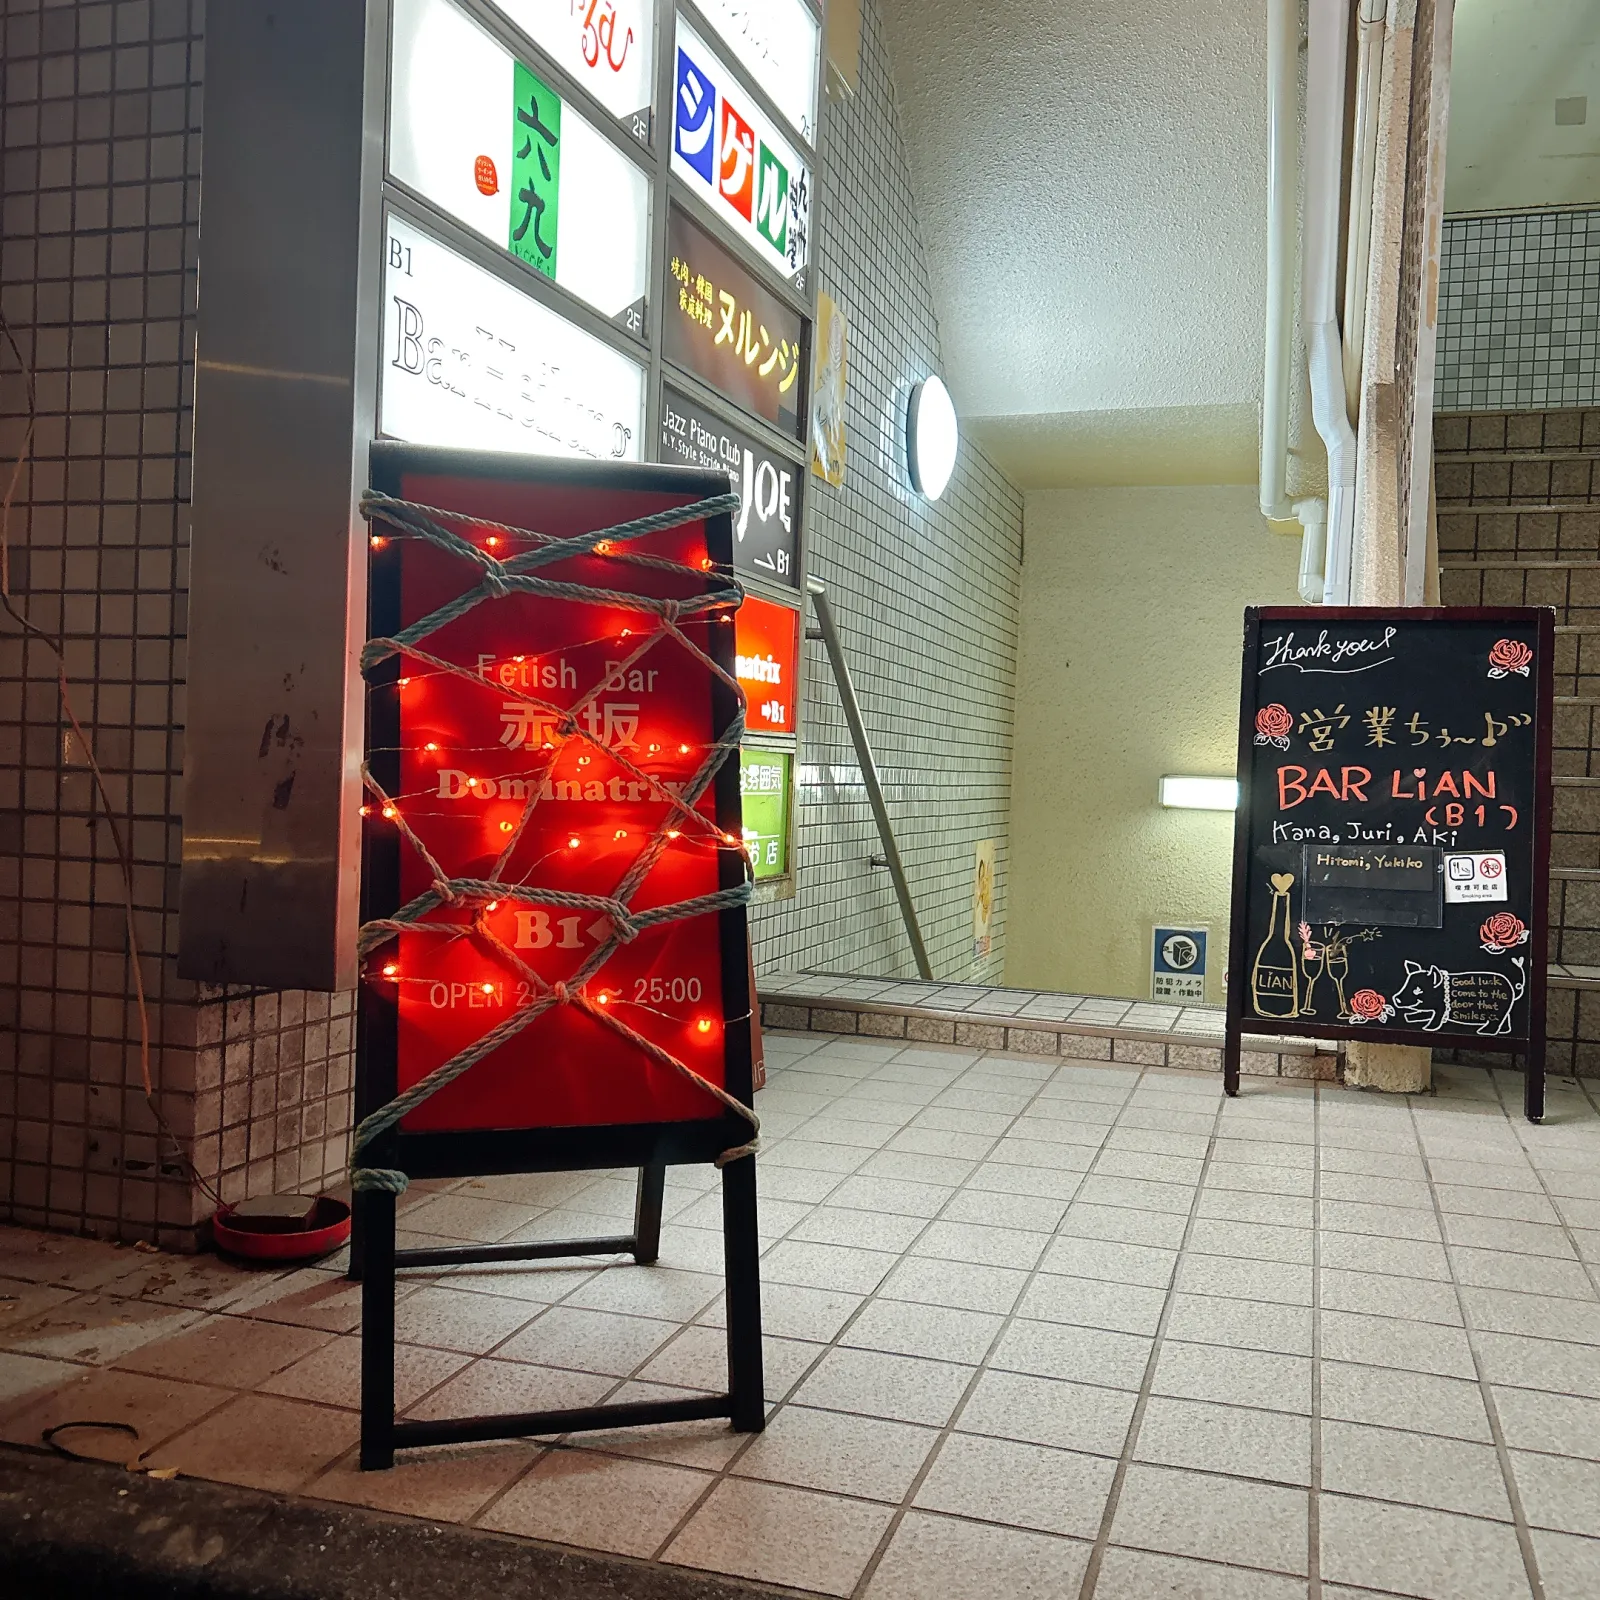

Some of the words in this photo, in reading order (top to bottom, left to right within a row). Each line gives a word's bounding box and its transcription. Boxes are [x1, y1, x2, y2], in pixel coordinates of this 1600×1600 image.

[631, 115, 648, 140] 2F
[679, 68, 788, 243] シゲル
[513, 95, 559, 260] 六九
[388, 235, 414, 278] B1
[626, 307, 642, 332] 2F
[714, 289, 799, 393] ヌルンジ
[662, 404, 687, 437] Jazz
[690, 418, 717, 454] Piano
[719, 435, 741, 466] Club
[736, 448, 791, 543] JOE
[776, 548, 790, 576] B1
[1263, 629, 1333, 666] Thank
[478, 653, 577, 690] Fetish
[605, 660, 659, 693] Bar
[499, 700, 641, 752] 赤坂
[771, 700, 785, 724] B1
[435, 769, 688, 803] Dominatrix
[1276, 765, 1373, 811] BAR
[1425, 802, 1518, 830] (B1)
[1272, 820, 1340, 844] Kana,
[1347, 822, 1405, 844] Juri,
[1316, 853, 1371, 871] Hitomi,
[1374, 854, 1423, 869] Yukiko
[1454, 883, 1498, 891] 喫煙可能店
[513, 909, 585, 949] B1
[429, 981, 503, 1009] OPEN
[634, 977, 702, 1004] 25:00
[1155, 976, 1202, 988] 防犯カメラ
[1155, 986, 1202, 997] 設置・作動中
[1451, 976, 1476, 987] Good
[1477, 989, 1489, 998] to
[1490, 989, 1508, 1000] the
[1450, 999, 1475, 1009] door
[1476, 1000, 1499, 1011] that
